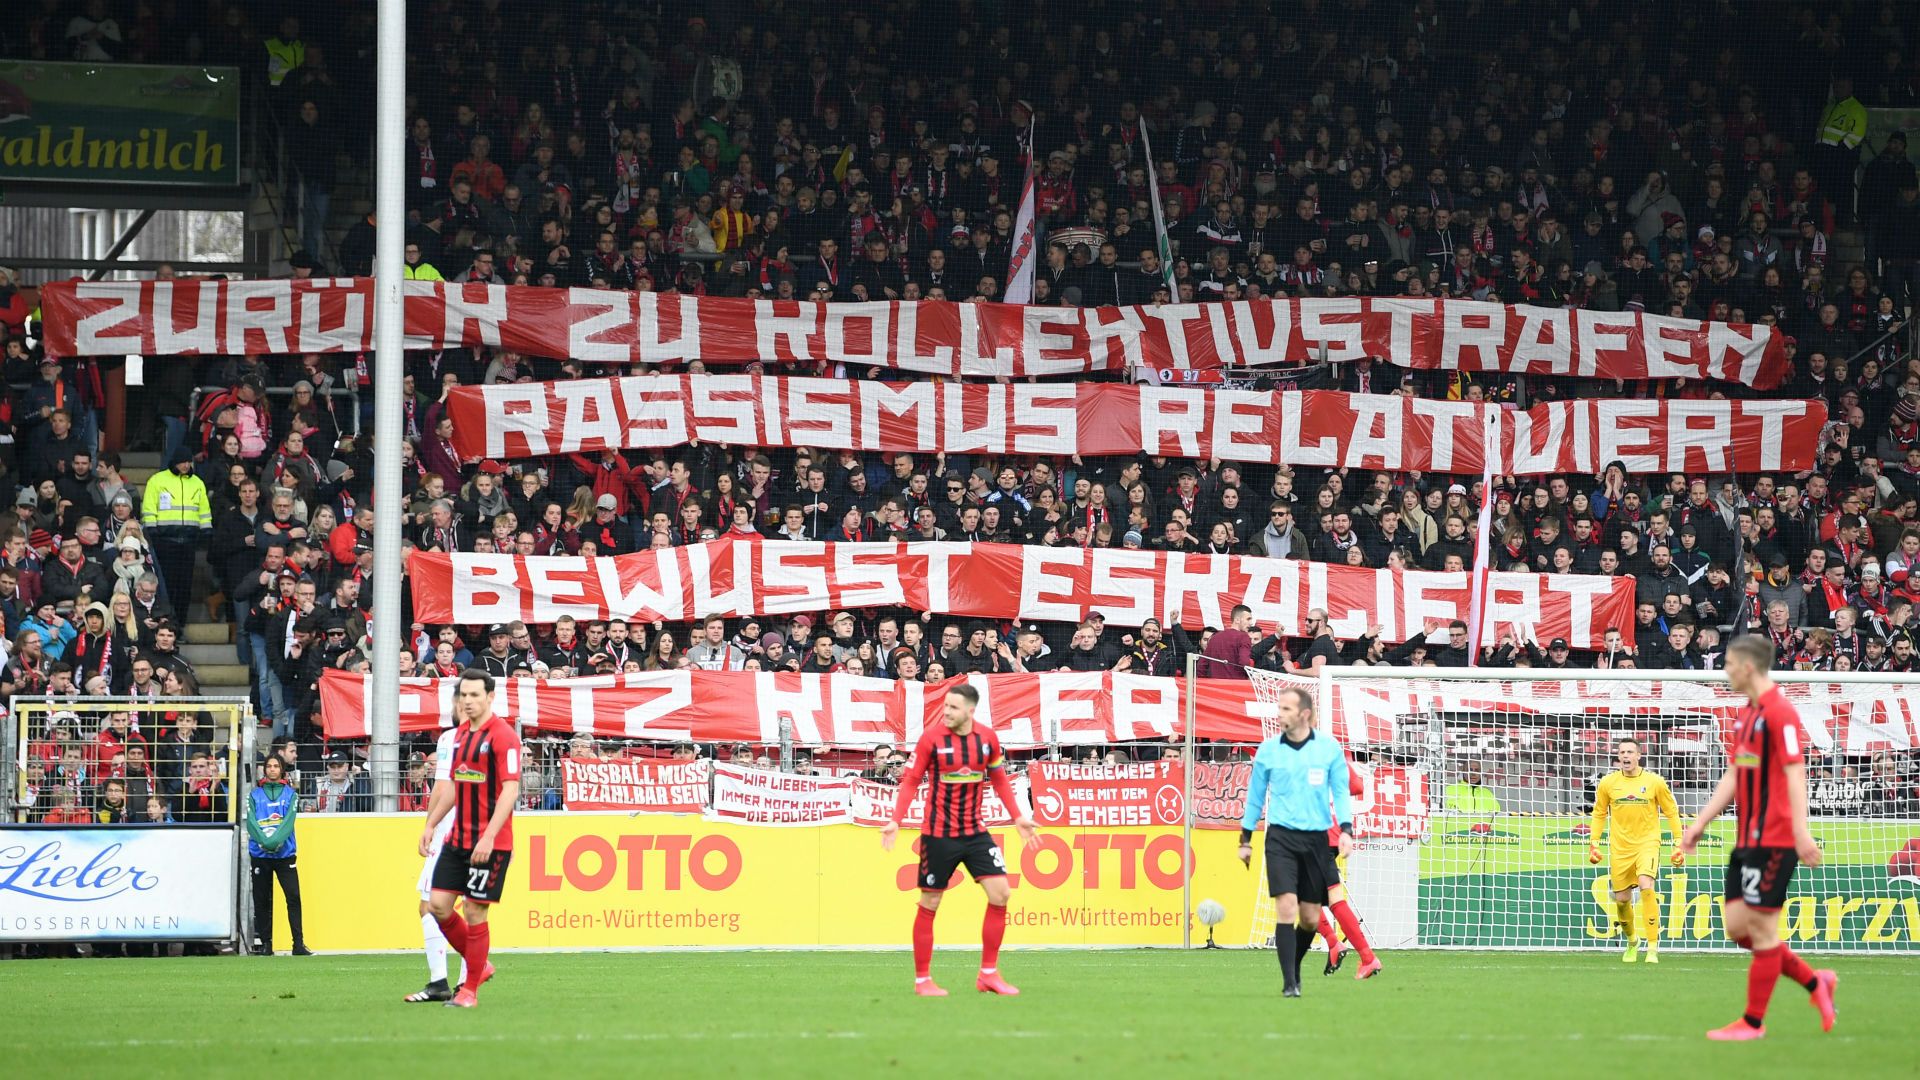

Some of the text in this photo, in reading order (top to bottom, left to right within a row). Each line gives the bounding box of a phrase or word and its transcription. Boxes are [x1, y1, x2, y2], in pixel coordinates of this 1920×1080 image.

[0, 125, 226, 172] aldmilch
[569, 287, 701, 362] ZU
[755, 297, 1771, 387] KOLLEKTIVSTRAFEN
[1183, 370, 1199, 382] 97
[482, 373, 1807, 473] RASSISMUS RELATIVIERT
[451, 539, 1613, 649] BEWUSST ESKALIERT
[565, 761, 709, 785] FUSSBALL MUSS
[743, 773, 817, 792] WIR LIEBEN
[1042, 762, 1170, 781] VIDEOBEWEIS ?
[567, 783, 709, 805] BEZAHLBAR SEIN
[722, 789, 760, 806] IMMER
[764, 797, 799, 809] NOCH
[1068, 787, 1148, 800] WEG MIT DEM
[746, 810, 823, 823] DIE POLIZEI
[1069, 805, 1151, 826] SCHEISS
[529, 834, 743, 892] LOTTO
[1650, 857, 1655, 870] 1
[467, 867, 490, 891] 27
[1005, 906, 1194, 931] aden-Württember
[1586, 873, 1920, 942] Sharz
[1, 915, 179, 930] LOSSBRUNNEN
[528, 908, 741, 933] Baden-Württemberg
